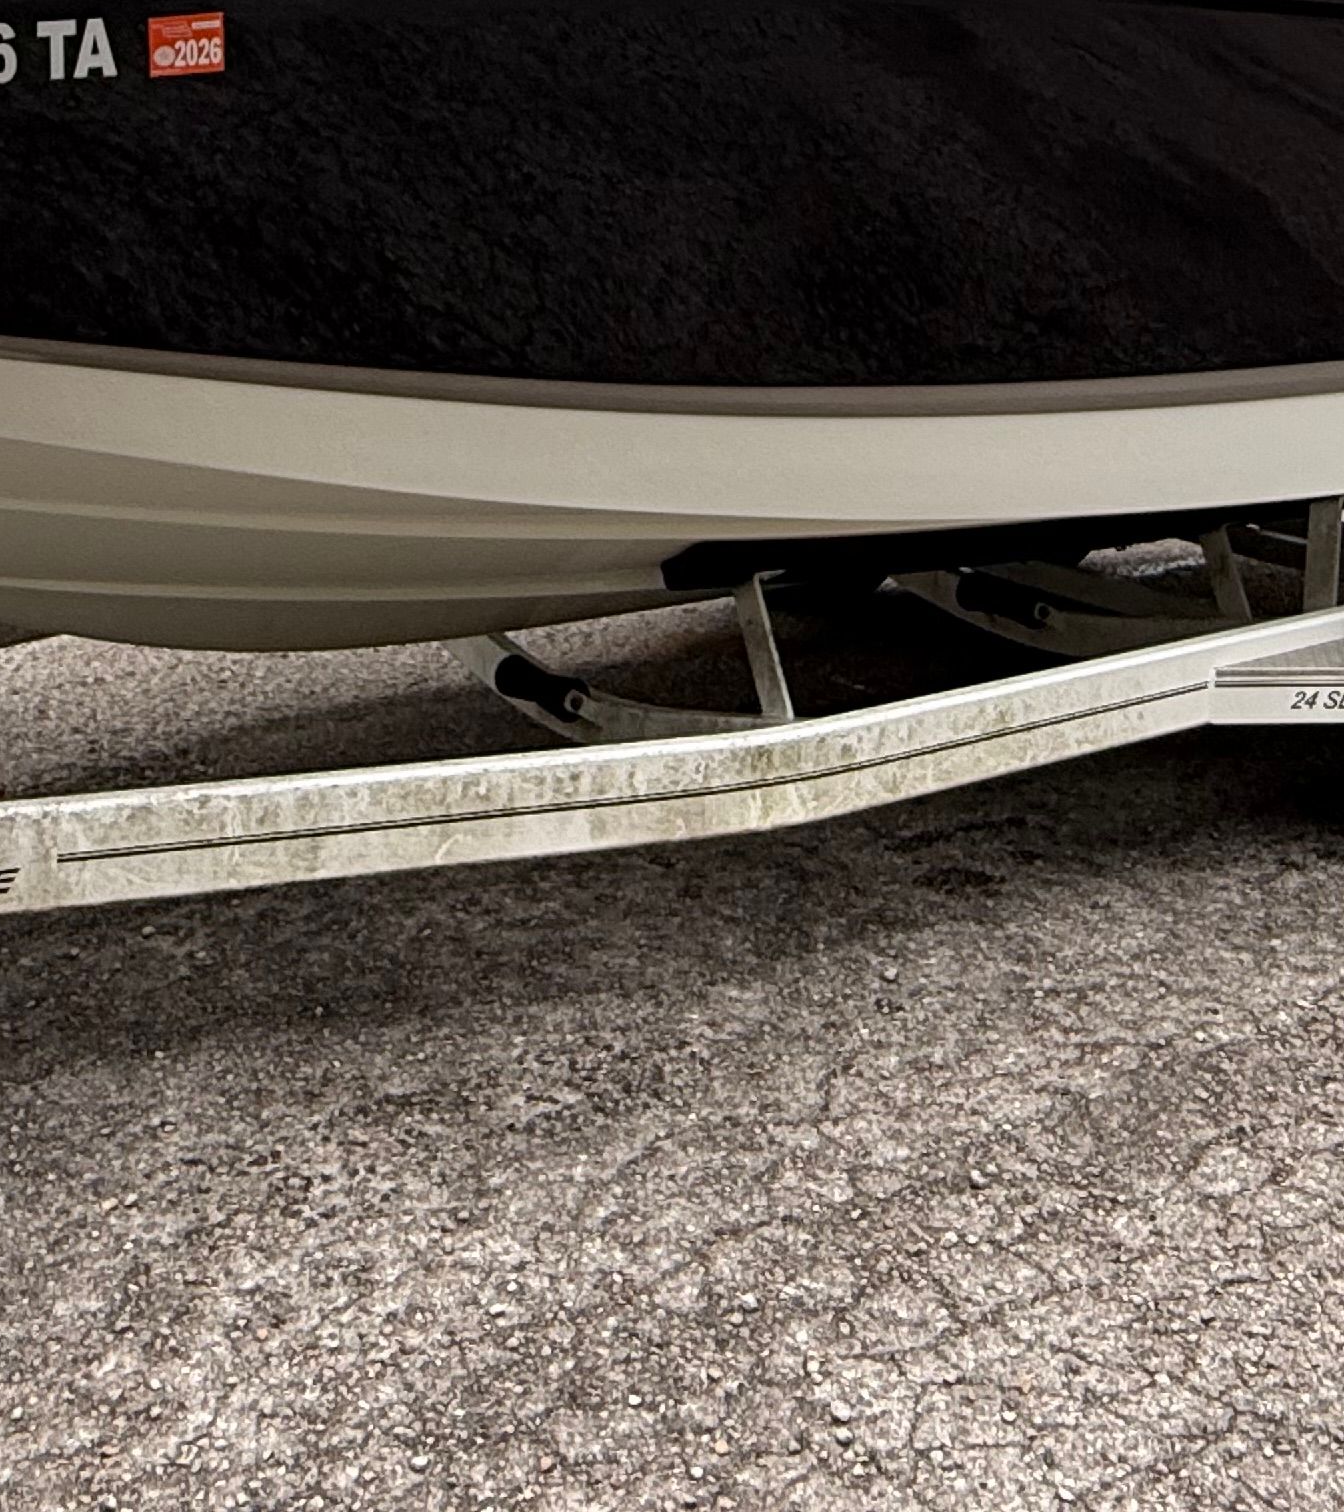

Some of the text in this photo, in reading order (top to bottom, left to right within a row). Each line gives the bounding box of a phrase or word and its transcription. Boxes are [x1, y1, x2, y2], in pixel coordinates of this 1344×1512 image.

[36, 17, 119, 81] TA
[174, 37, 222, 67] 2026
[1290, 690, 1318, 710] 24
